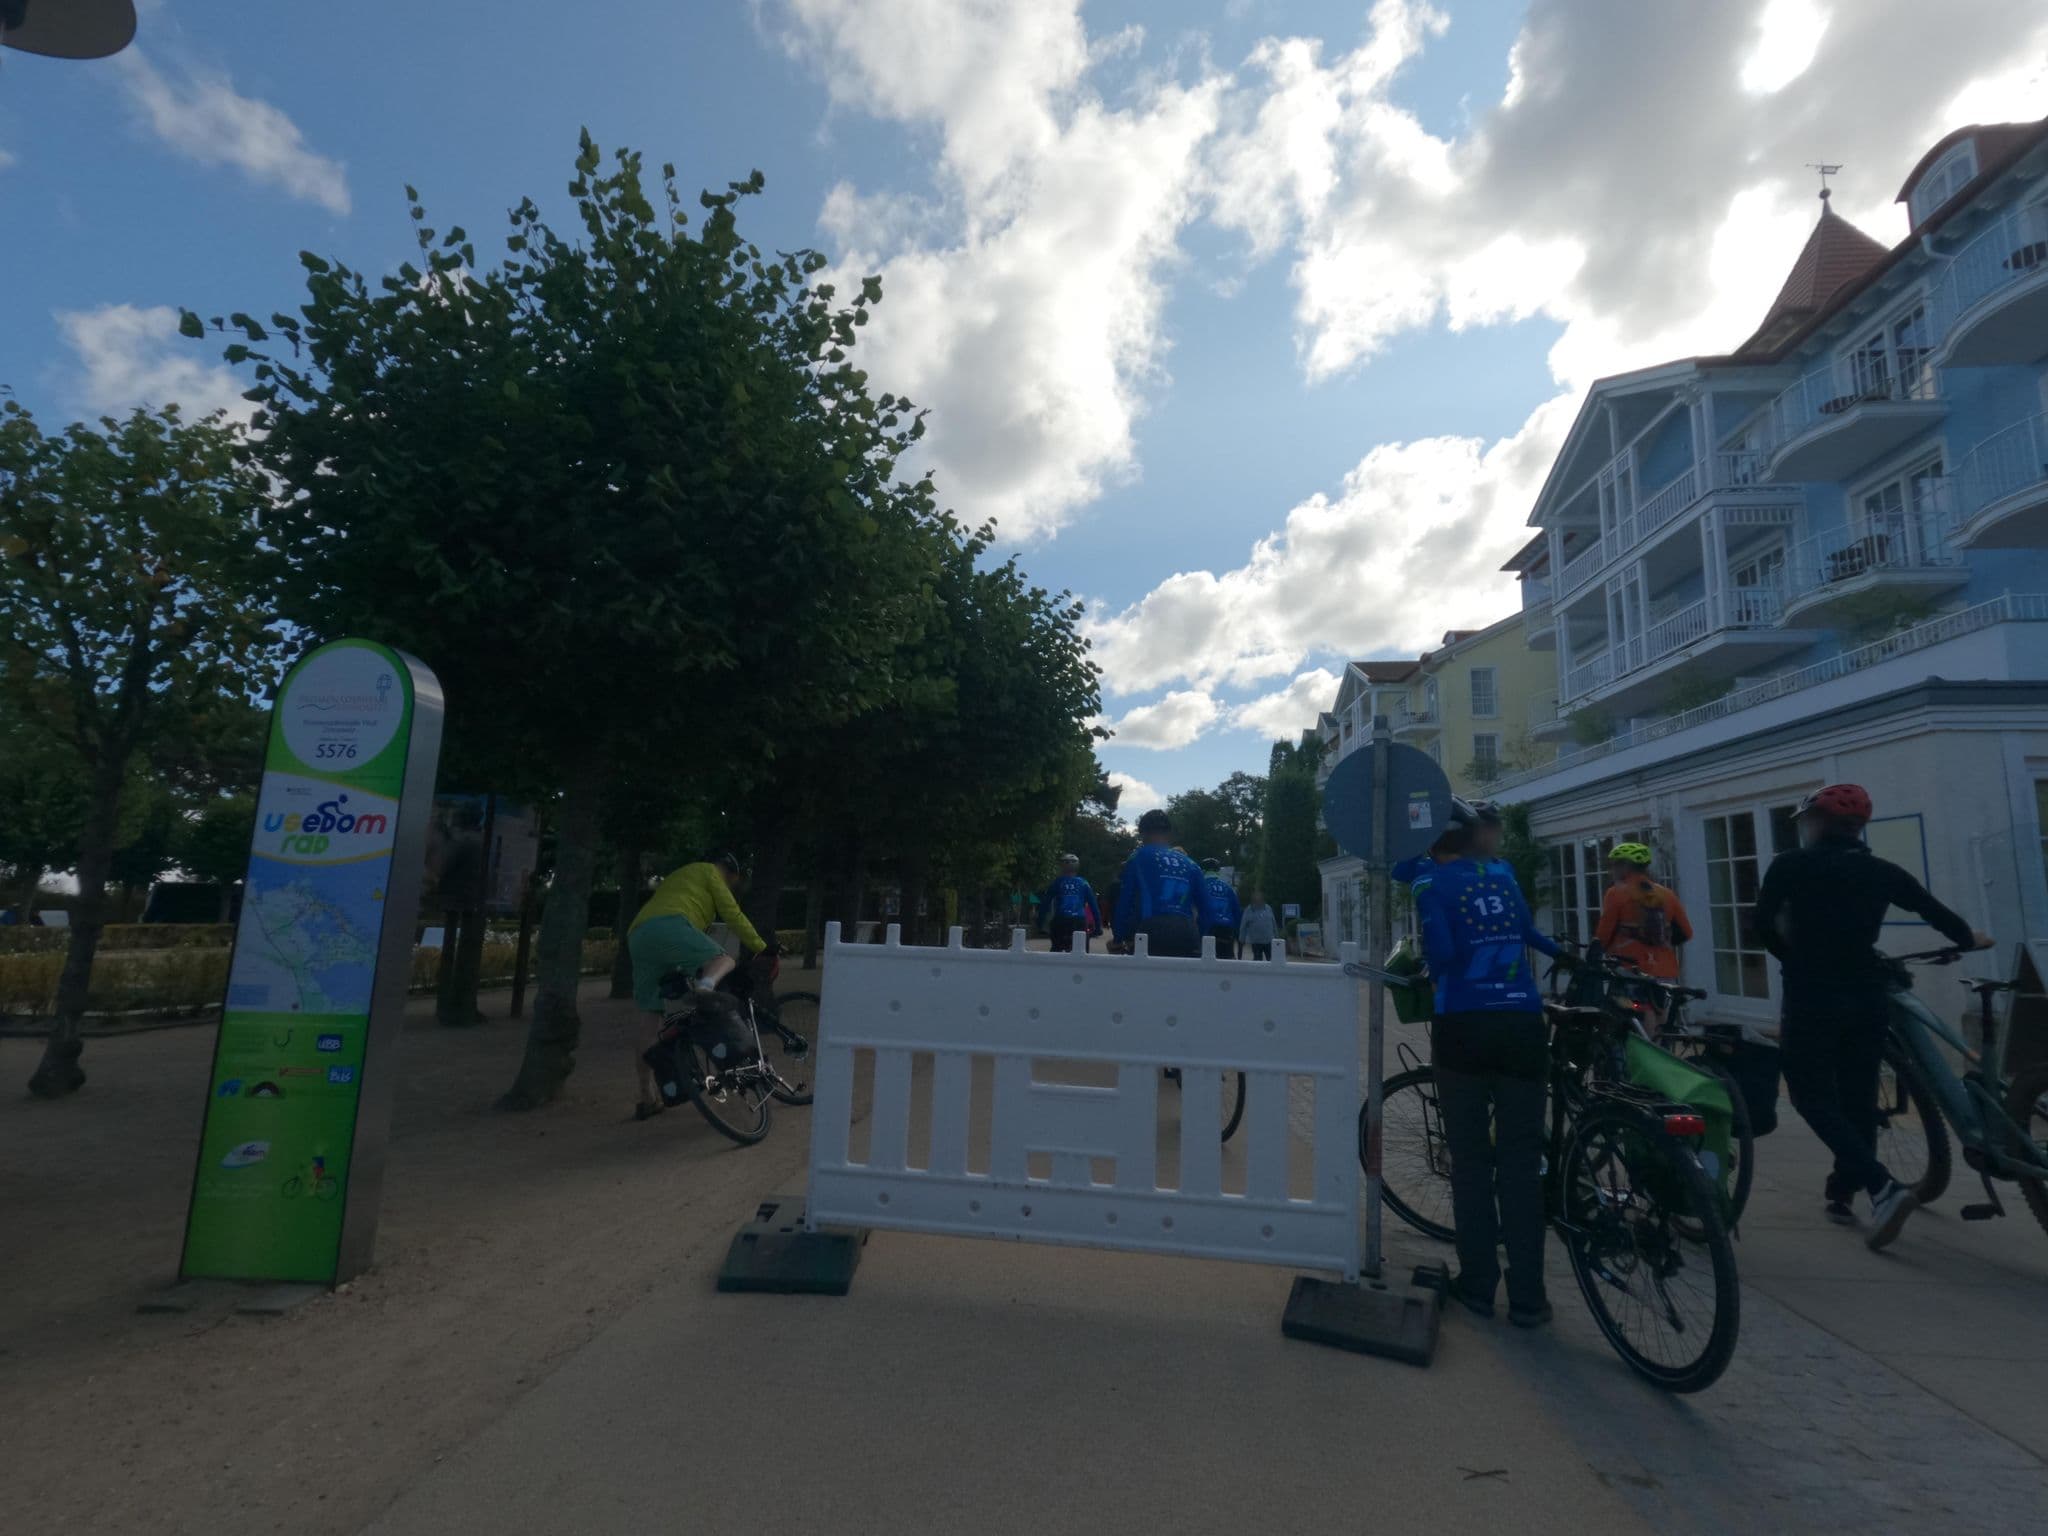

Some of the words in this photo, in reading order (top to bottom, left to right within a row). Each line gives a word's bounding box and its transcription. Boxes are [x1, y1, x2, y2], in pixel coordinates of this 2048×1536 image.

[315, 744, 358, 758] 5576
[1162, 855, 1180, 867] 13
[1473, 896, 1504, 916] 13
